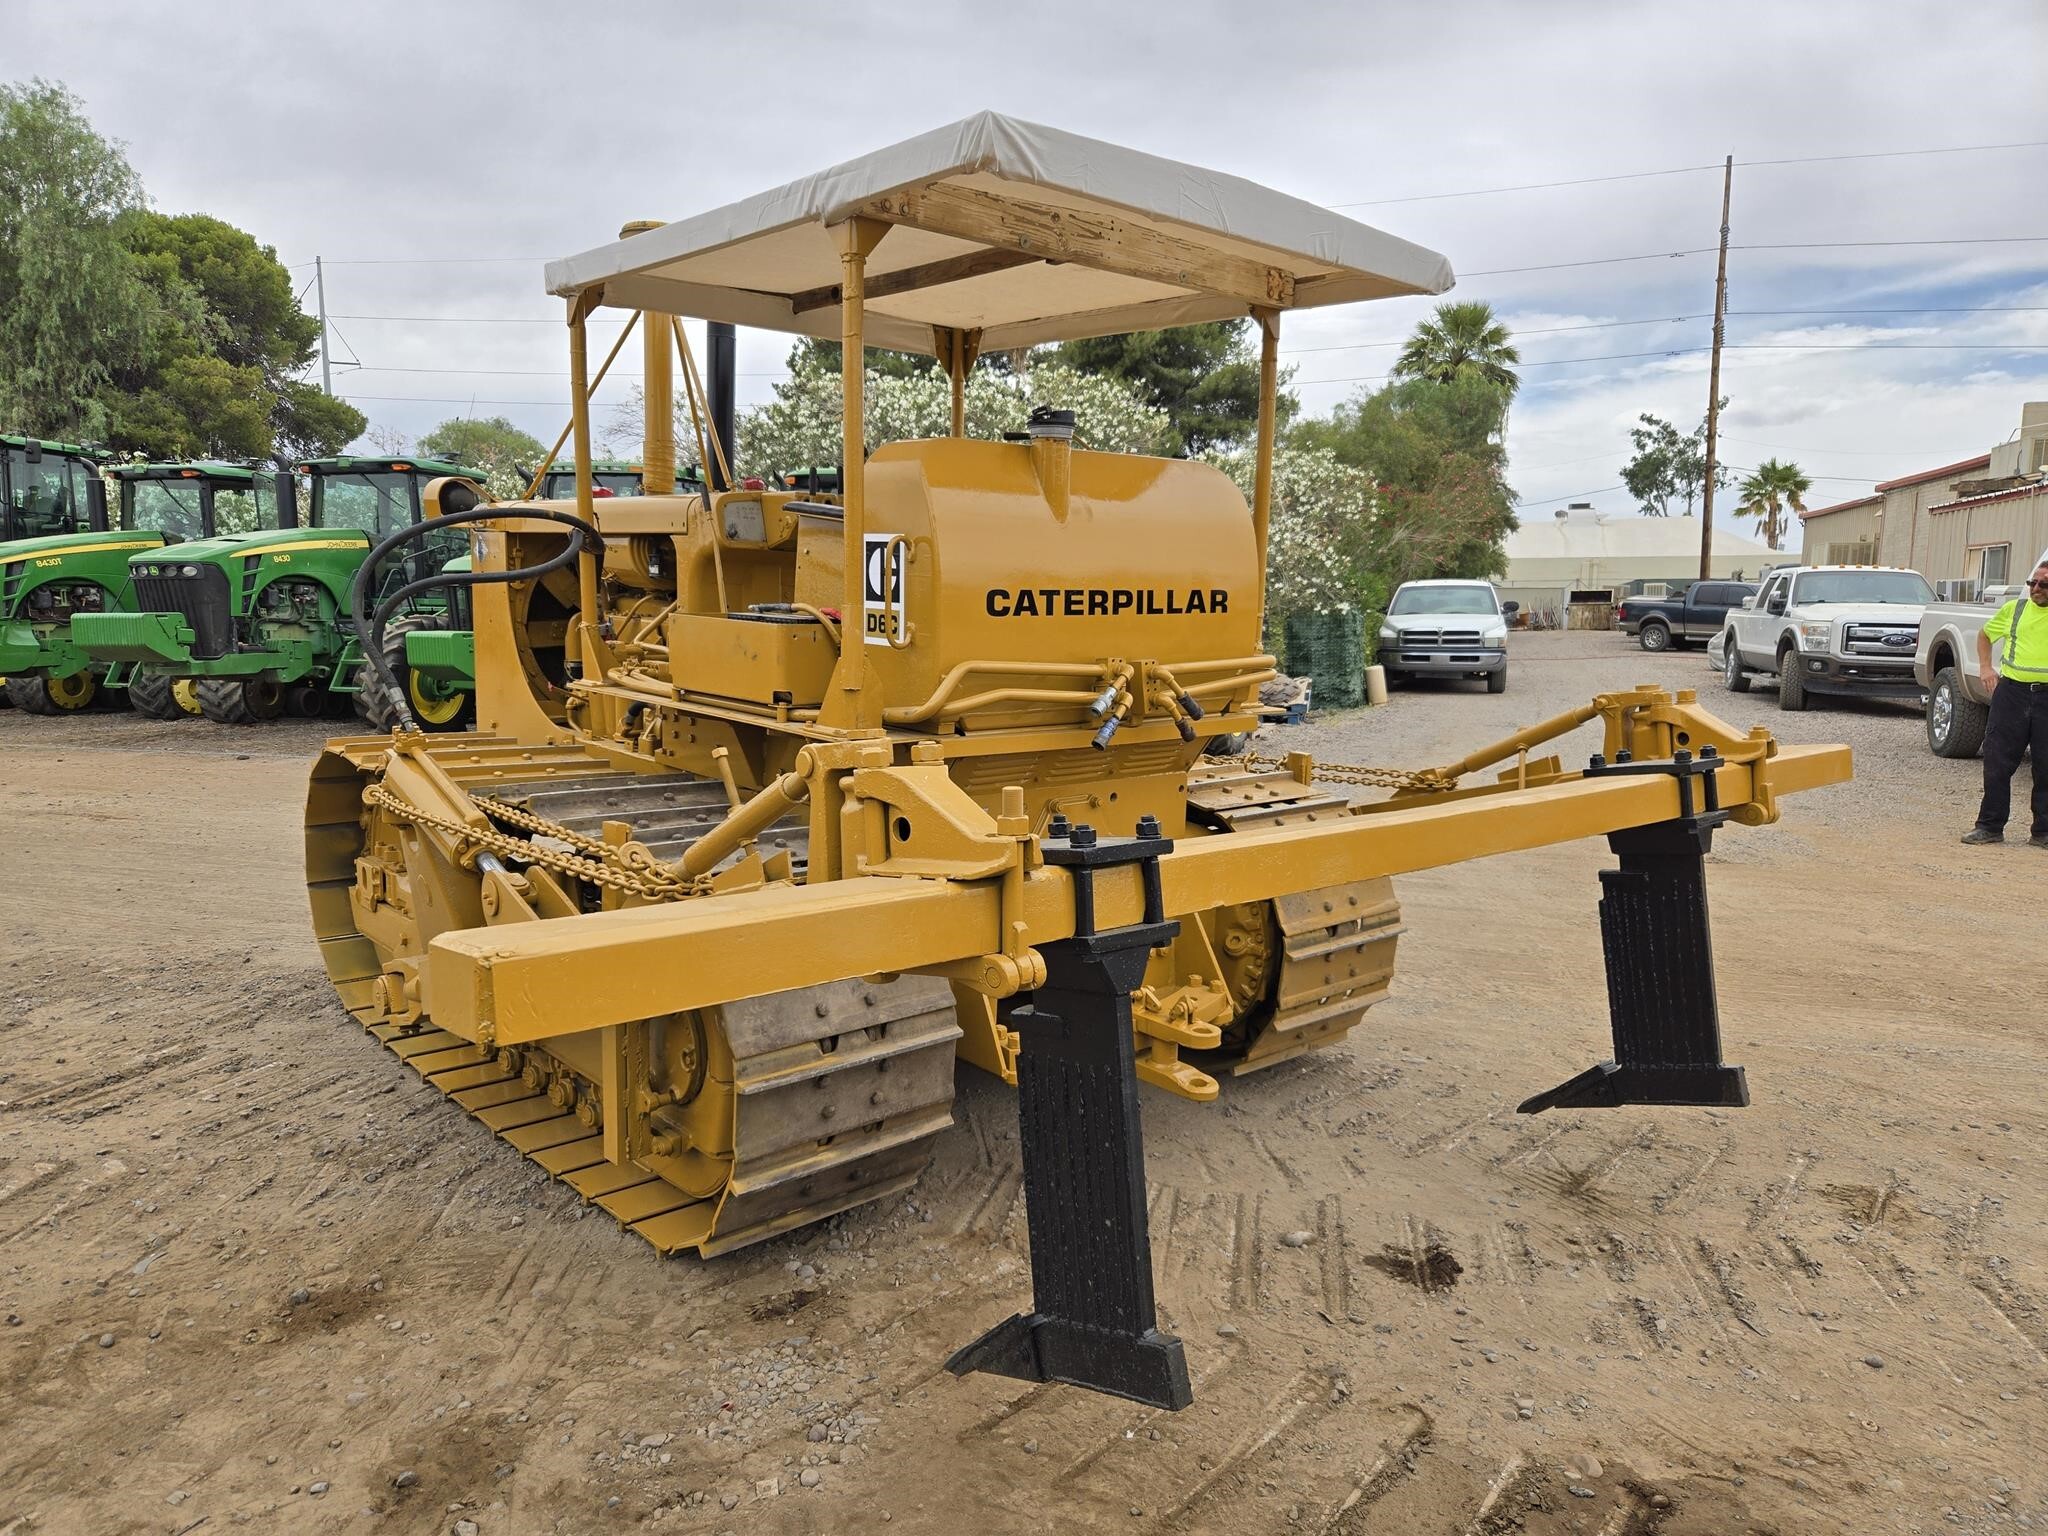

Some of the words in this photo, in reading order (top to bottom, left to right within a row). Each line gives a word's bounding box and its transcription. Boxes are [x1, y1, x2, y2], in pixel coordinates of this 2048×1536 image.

[35, 557, 63, 568] 8430T
[273, 554, 291, 563] 8430
[986, 589, 1229, 617] CATERPILLAR
[867, 613, 898, 635] D6C
